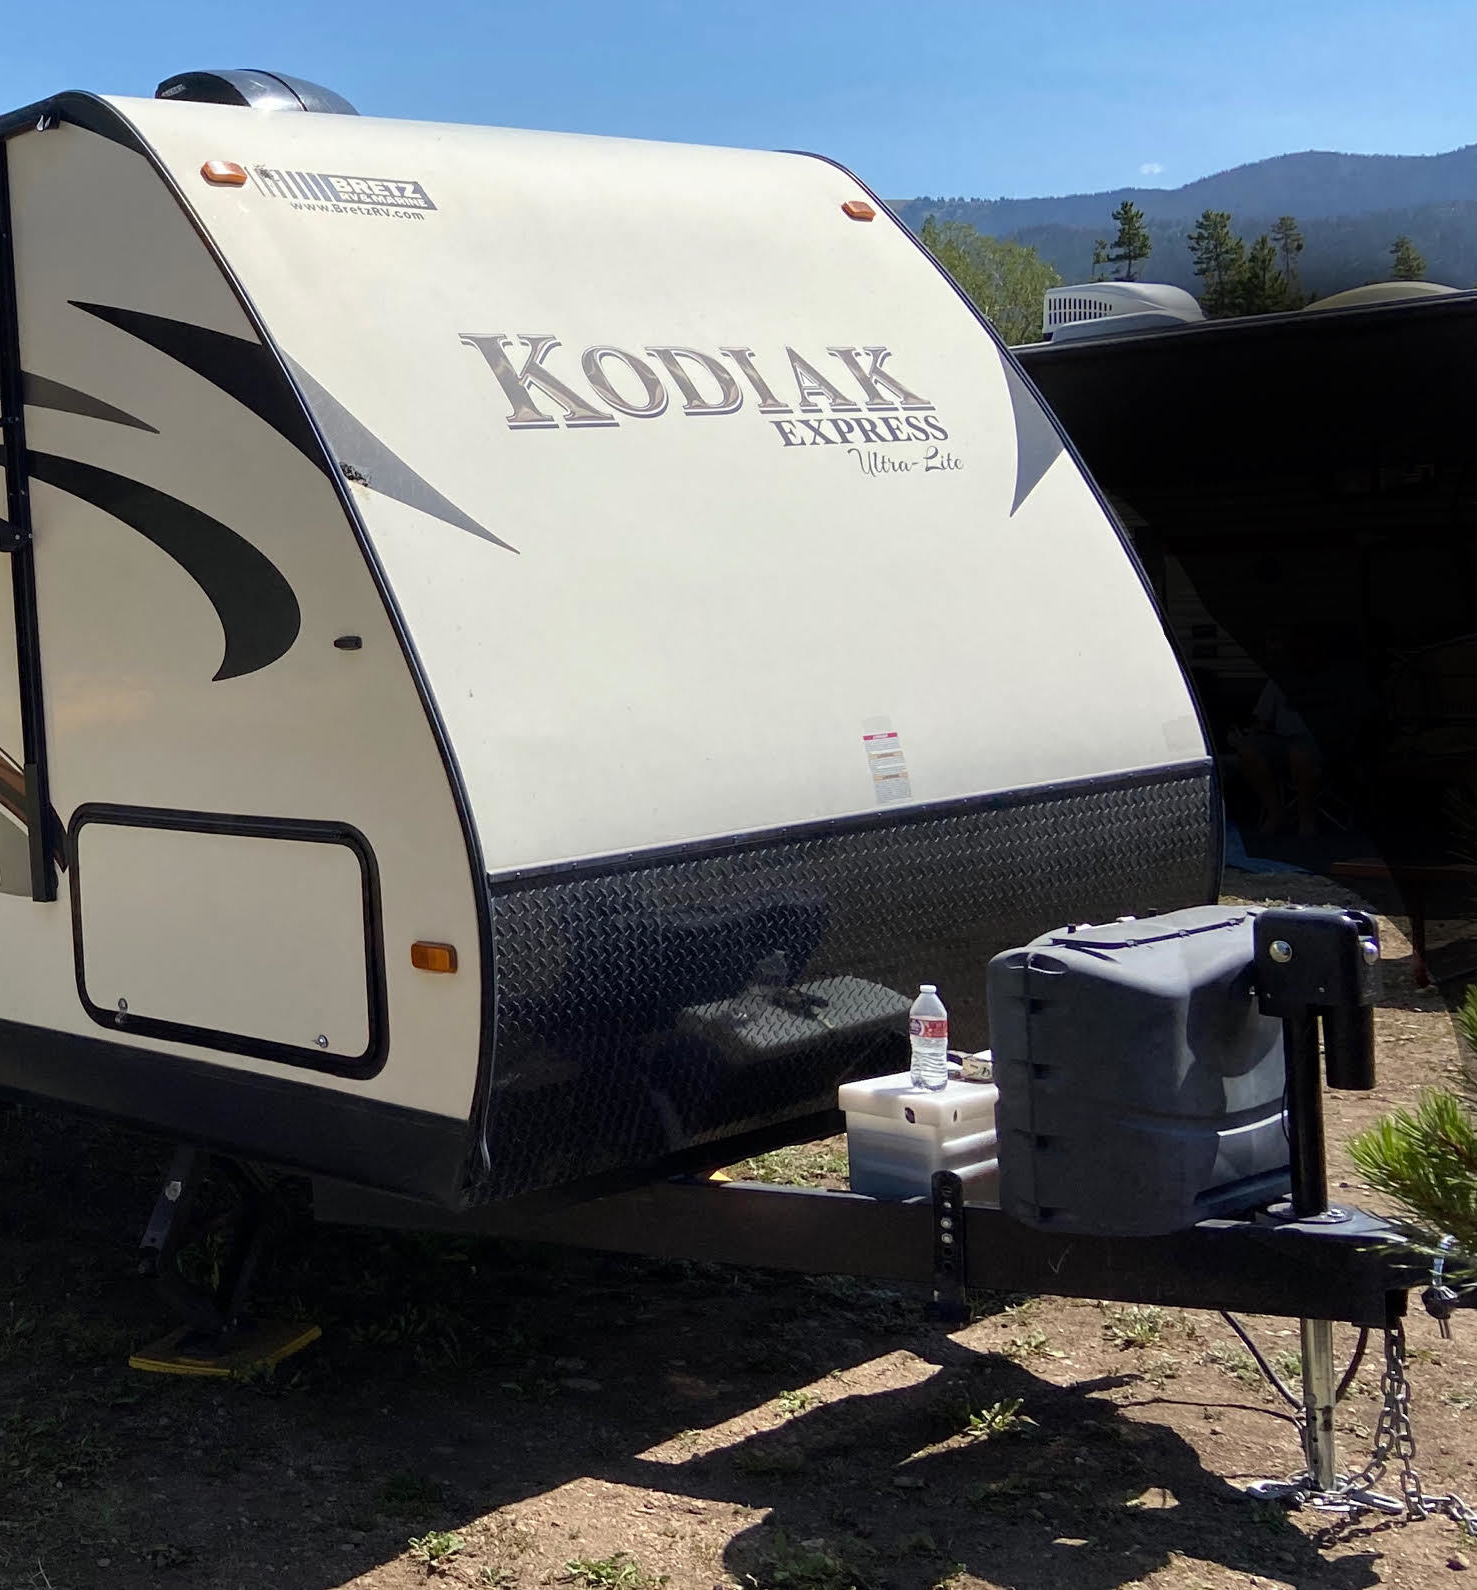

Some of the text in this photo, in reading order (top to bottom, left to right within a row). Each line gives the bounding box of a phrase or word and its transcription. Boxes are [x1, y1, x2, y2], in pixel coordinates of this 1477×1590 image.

[328, 177, 422, 198] BRETZ
[291, 203, 425, 220] www.BretzRV.com
[458, 333, 936, 430] KODIAK
[769, 415, 949, 447] EXPRESS
[847, 446, 964, 477] Ultra-Lite
